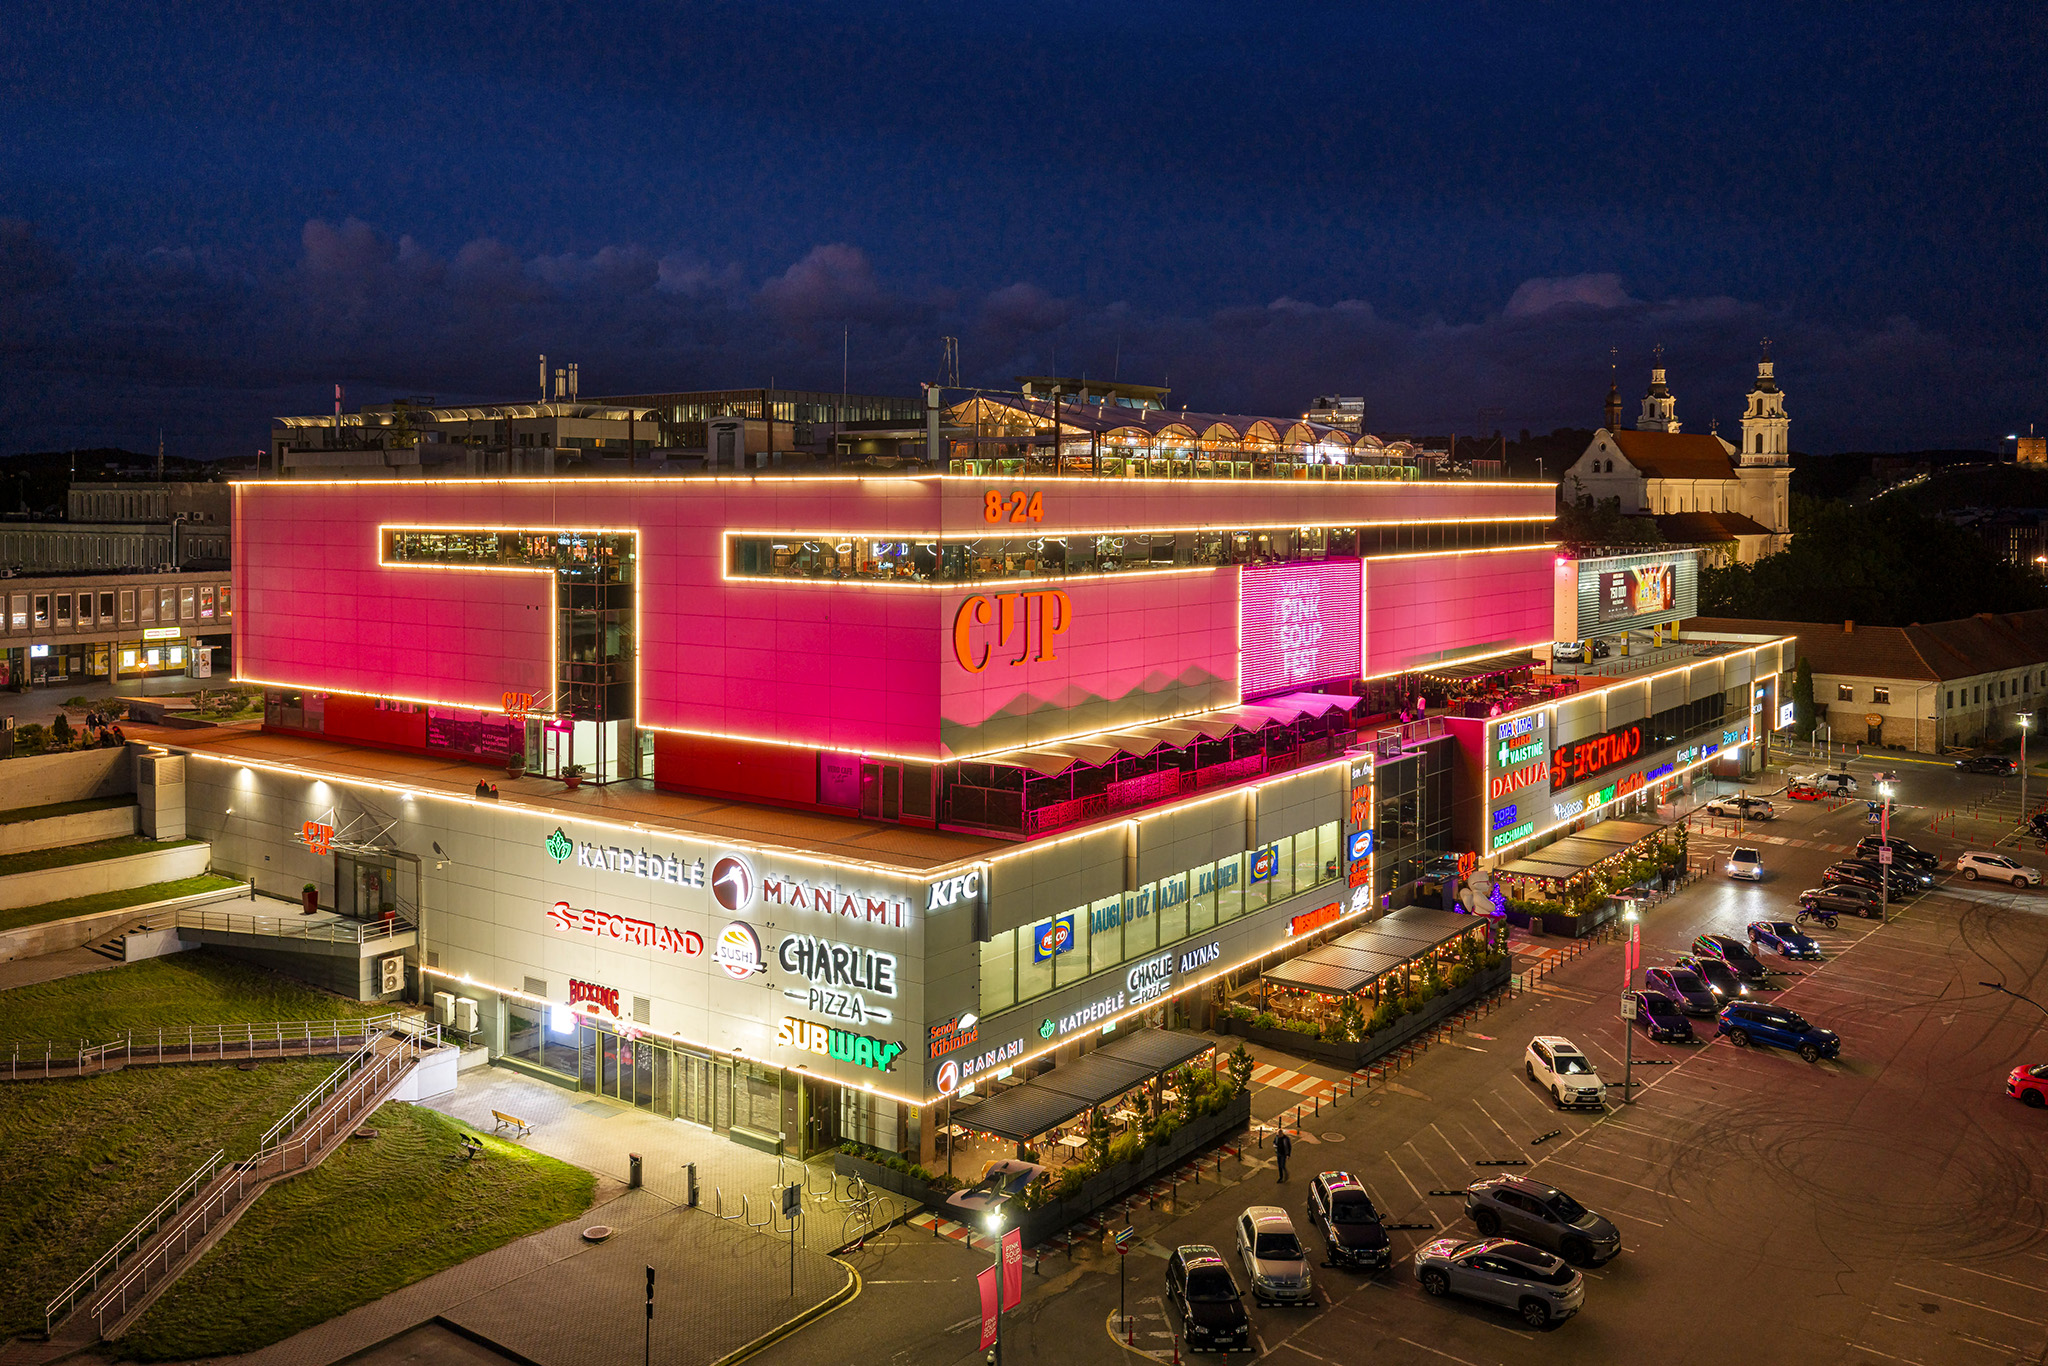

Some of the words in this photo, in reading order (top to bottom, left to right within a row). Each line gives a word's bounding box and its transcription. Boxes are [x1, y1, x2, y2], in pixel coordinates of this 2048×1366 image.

[984, 489, 1044, 524] 8-24
[1281, 597, 1320, 622] PINK
[954, 590, 1072, 673] CUP
[1281, 622, 1322, 649] SOUP
[1283, 647, 1319, 676] FEST
[501, 691, 533, 711] CUP
[1498, 715, 1533, 740] MAXIMA
[1509, 733, 1531, 749] EURO
[1509, 738, 1544, 765] VAISTINĖ
[1573, 726, 1641, 779] SPORTLAND
[1491, 760, 1549, 800] DANIJA
[1493, 804, 1517, 823] TOPO
[303, 820, 335, 845] CUP
[1493, 821, 1534, 849] DEICHMANN
[578, 842, 705, 889] KATPĖDĖLĖ
[1457, 851, 1476, 873] CUP
[763, 877, 907, 928] MANAMI
[926, 871, 980, 910] KFC
[1136, 888, 1150, 918] UŽ
[580, 909, 704, 958] SPORTLAND
[1044, 931, 1066, 946] PECO
[720, 946, 753, 964] SUSHI
[778, 936, 894, 993] CHARLIE
[1180, 941, 1220, 973] ALYNAS
[1130, 954, 1173, 990] CHARLIE
[568, 978, 619, 1017] BOXING
[807, 988, 865, 1022] PIZZA
[1141, 984, 1163, 1004] PIZZA
[931, 1018, 958, 1039] Senoji
[1059, 992, 1124, 1035] KATPĖDĖLĖ
[775, 1016, 907, 1072] SUBWAY
[931, 1025, 978, 1059] Kibininė
[962, 1038, 1024, 1078] MANAMI
[1005, 1247, 1020, 1260] SOUP
[1006, 1241, 1019, 1252] PINK
